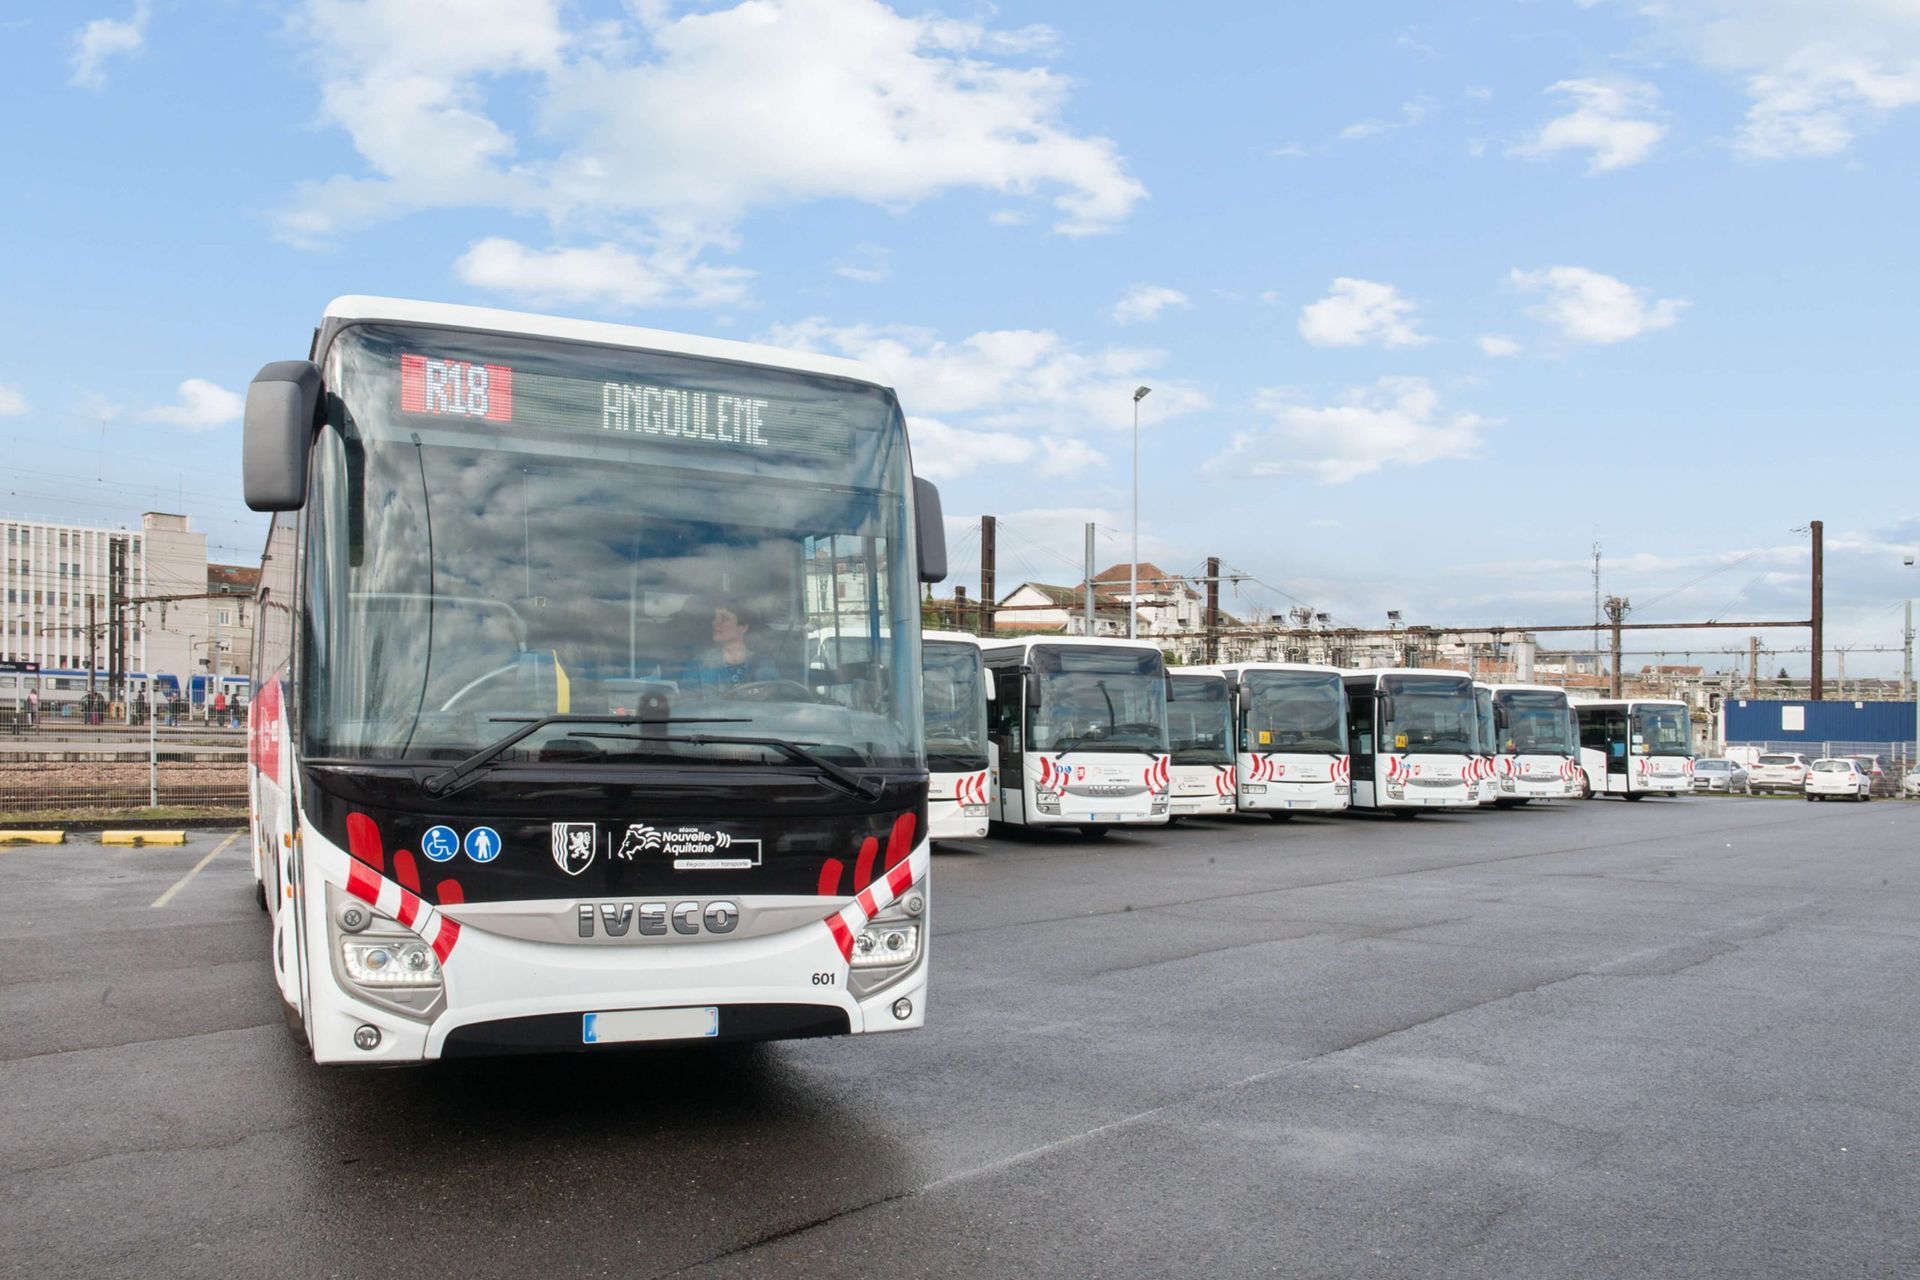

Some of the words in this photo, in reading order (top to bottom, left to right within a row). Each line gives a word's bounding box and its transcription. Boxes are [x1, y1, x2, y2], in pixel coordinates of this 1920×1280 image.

[426, 358, 489, 416] R18
[603, 382, 769, 446] ANGOULEME
[663, 832, 715, 842] Nouvelle-
[663, 843, 715, 856] Aquitaine
[578, 900, 739, 938] IVECO
[812, 973, 835, 985] 601
